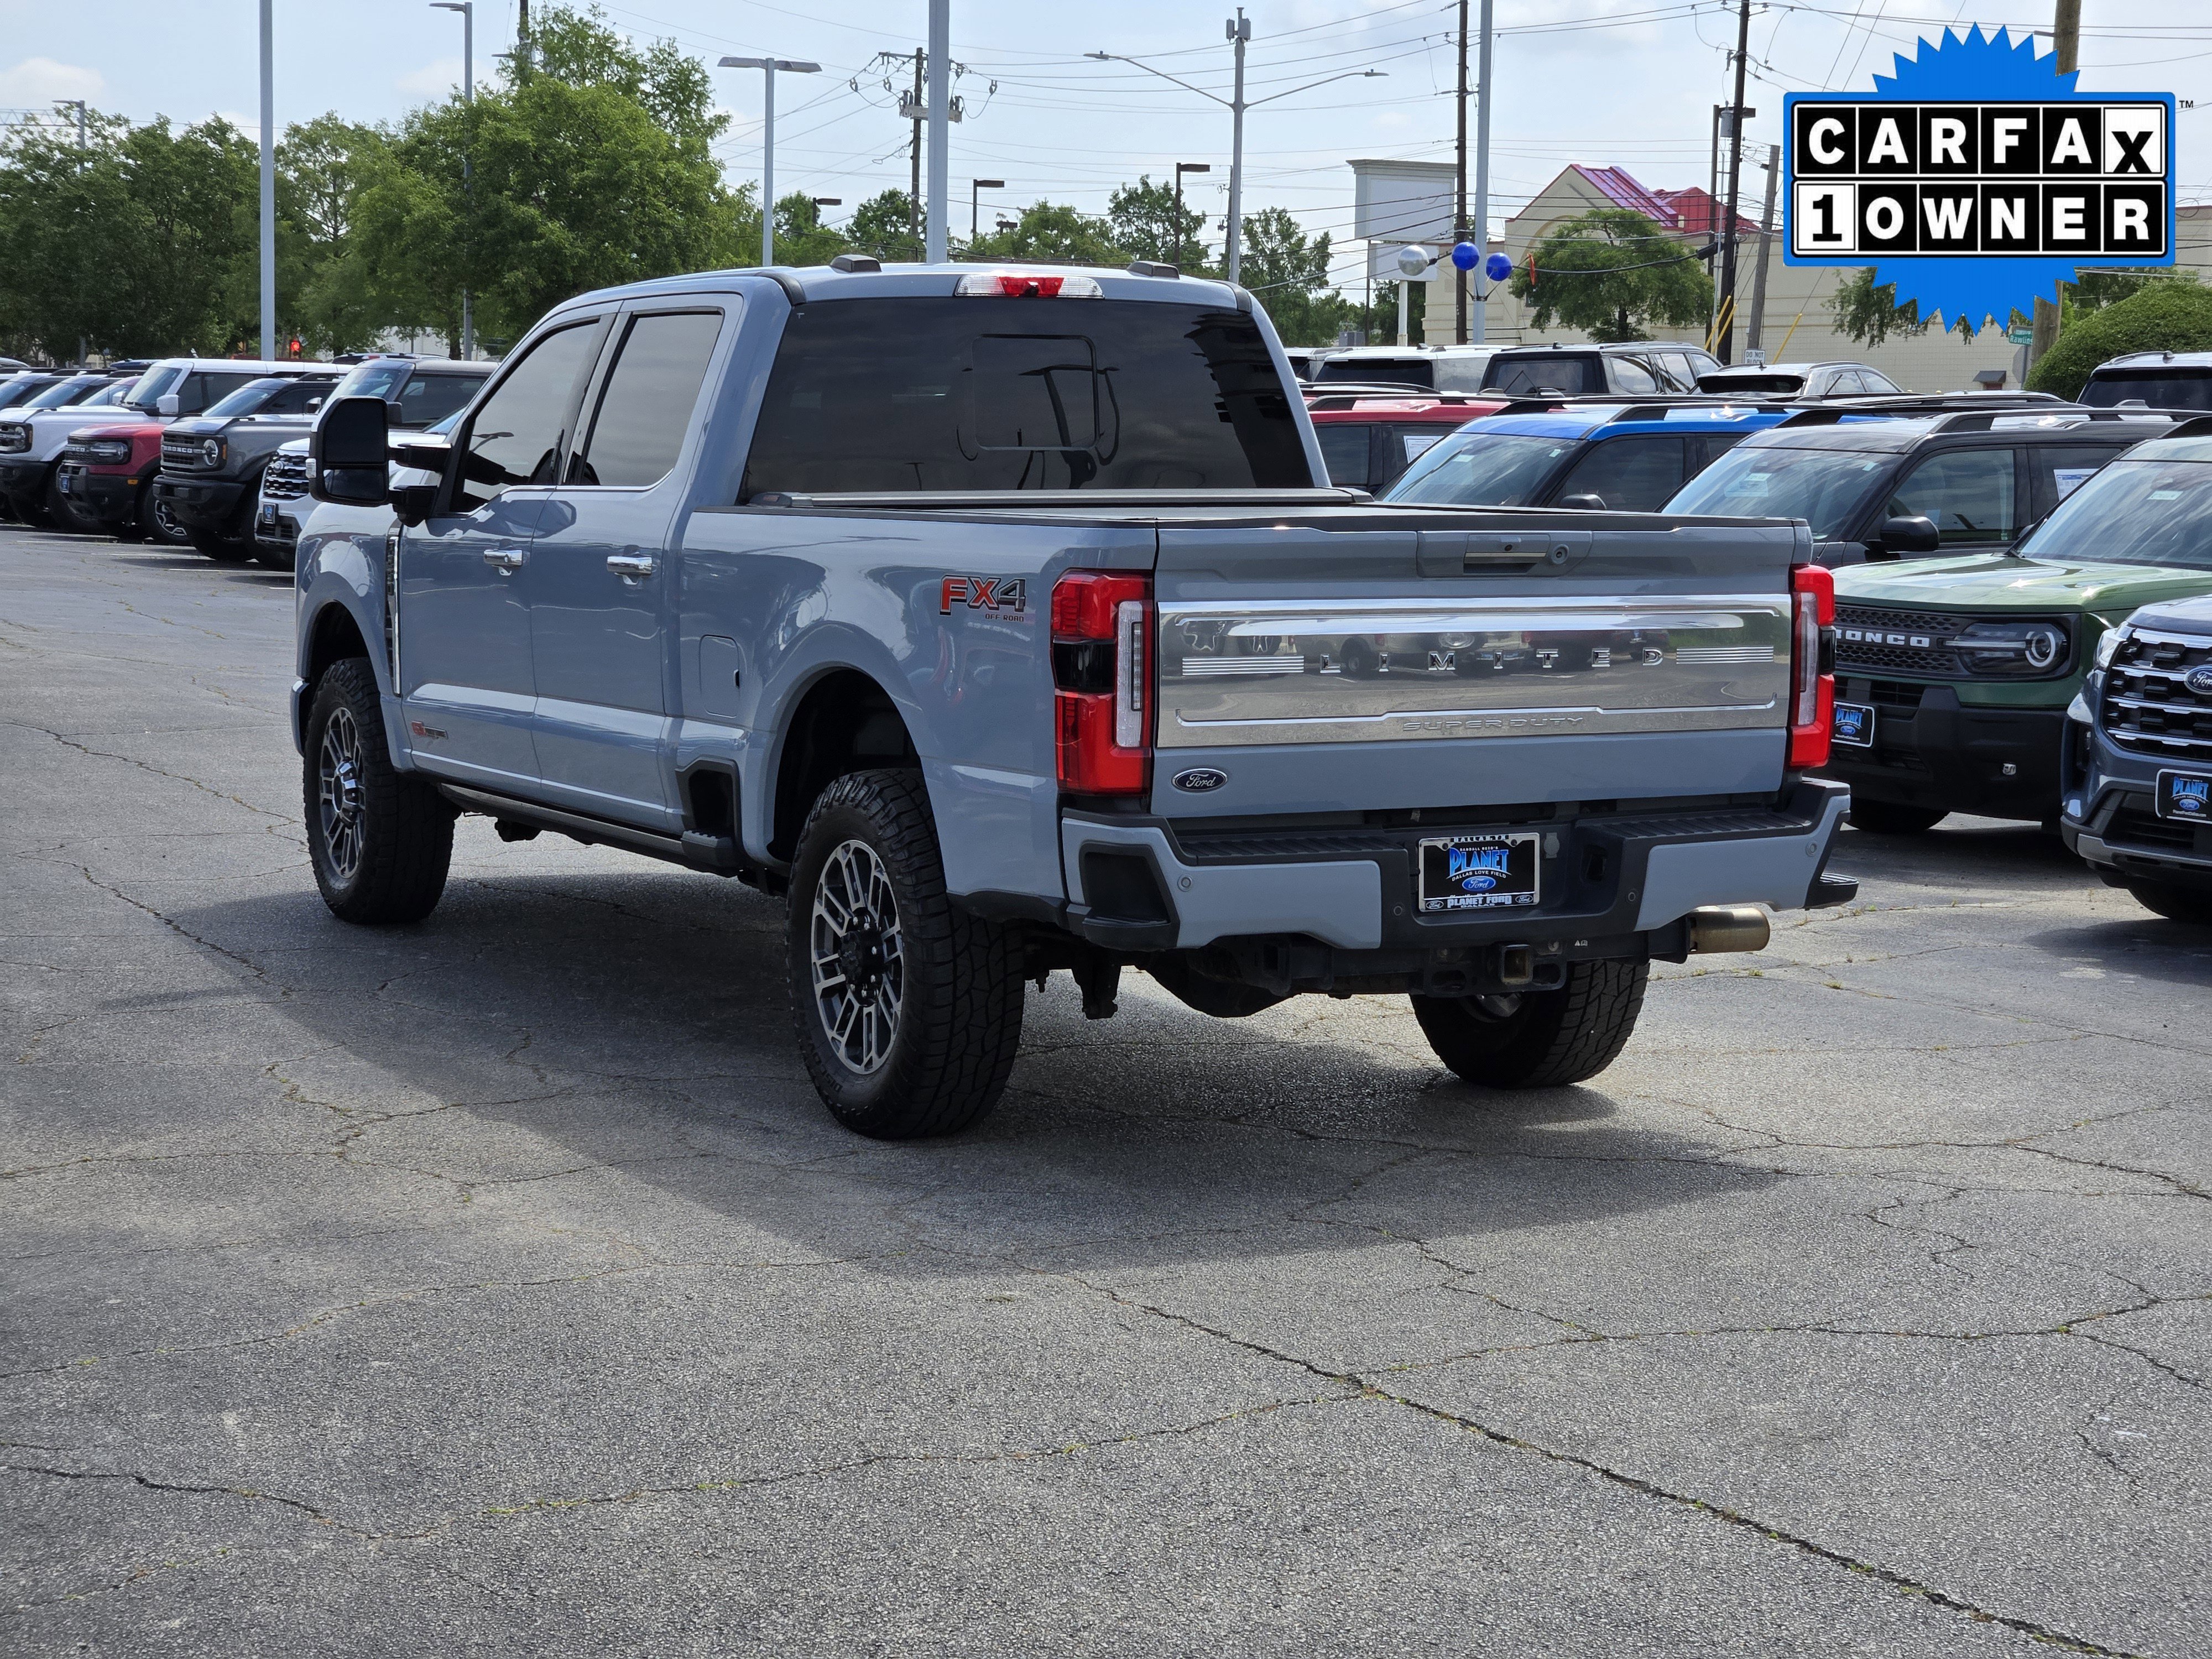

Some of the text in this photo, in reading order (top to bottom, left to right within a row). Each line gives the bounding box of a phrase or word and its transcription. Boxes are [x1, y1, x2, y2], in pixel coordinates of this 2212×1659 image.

[939, 575, 1026, 615] FX4
[1319, 647, 1663, 674] LIMITED
[1402, 717, 1584, 731] SUPER DUTY
[1836, 707, 1863, 727] PLANET
[1186, 773, 1217, 787] Ford
[2173, 776, 2209, 800] PLANET
[1449, 847, 1509, 877] PLANET
[1452, 872, 1473, 881] DALLAS
[1490, 870, 1506, 879] FIELD
[1468, 878, 1489, 889] Ford
[1447, 895, 1512, 909] PLANET FORD
